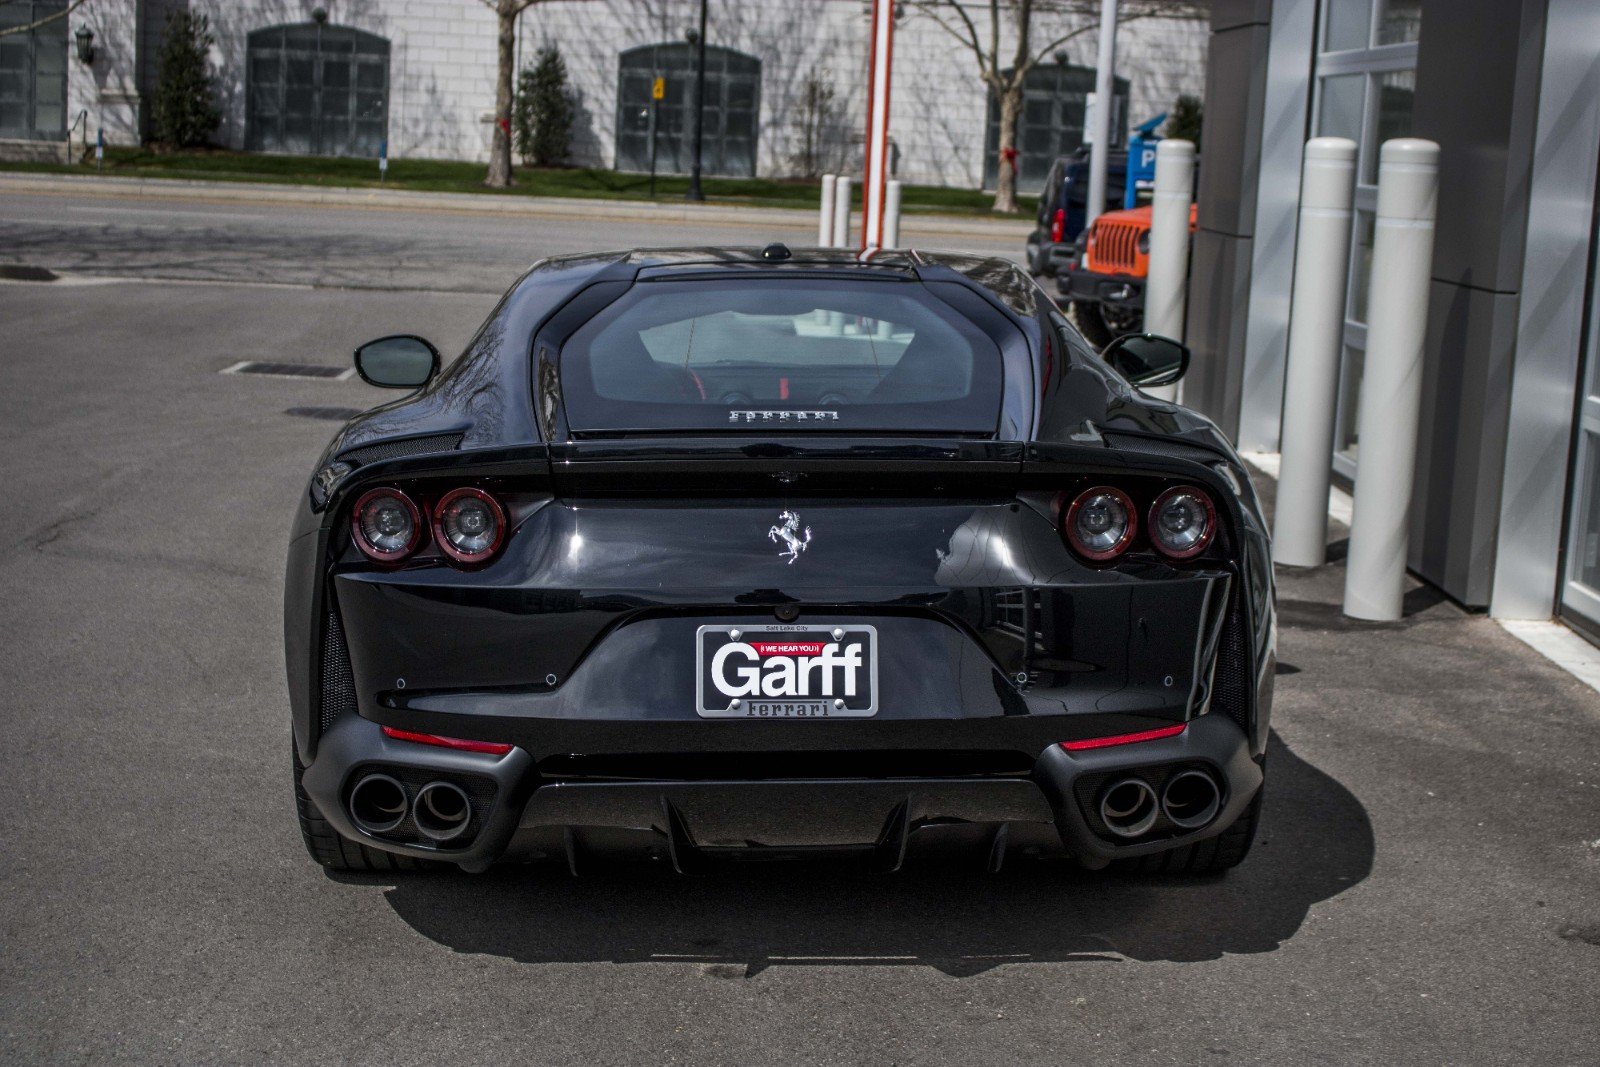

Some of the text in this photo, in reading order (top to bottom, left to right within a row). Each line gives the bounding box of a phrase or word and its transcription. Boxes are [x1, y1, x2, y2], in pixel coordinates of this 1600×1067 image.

[729, 410, 839, 420] Ferrari
[711, 642, 862, 697] Garff
[747, 701, 829, 716] Ferrari
